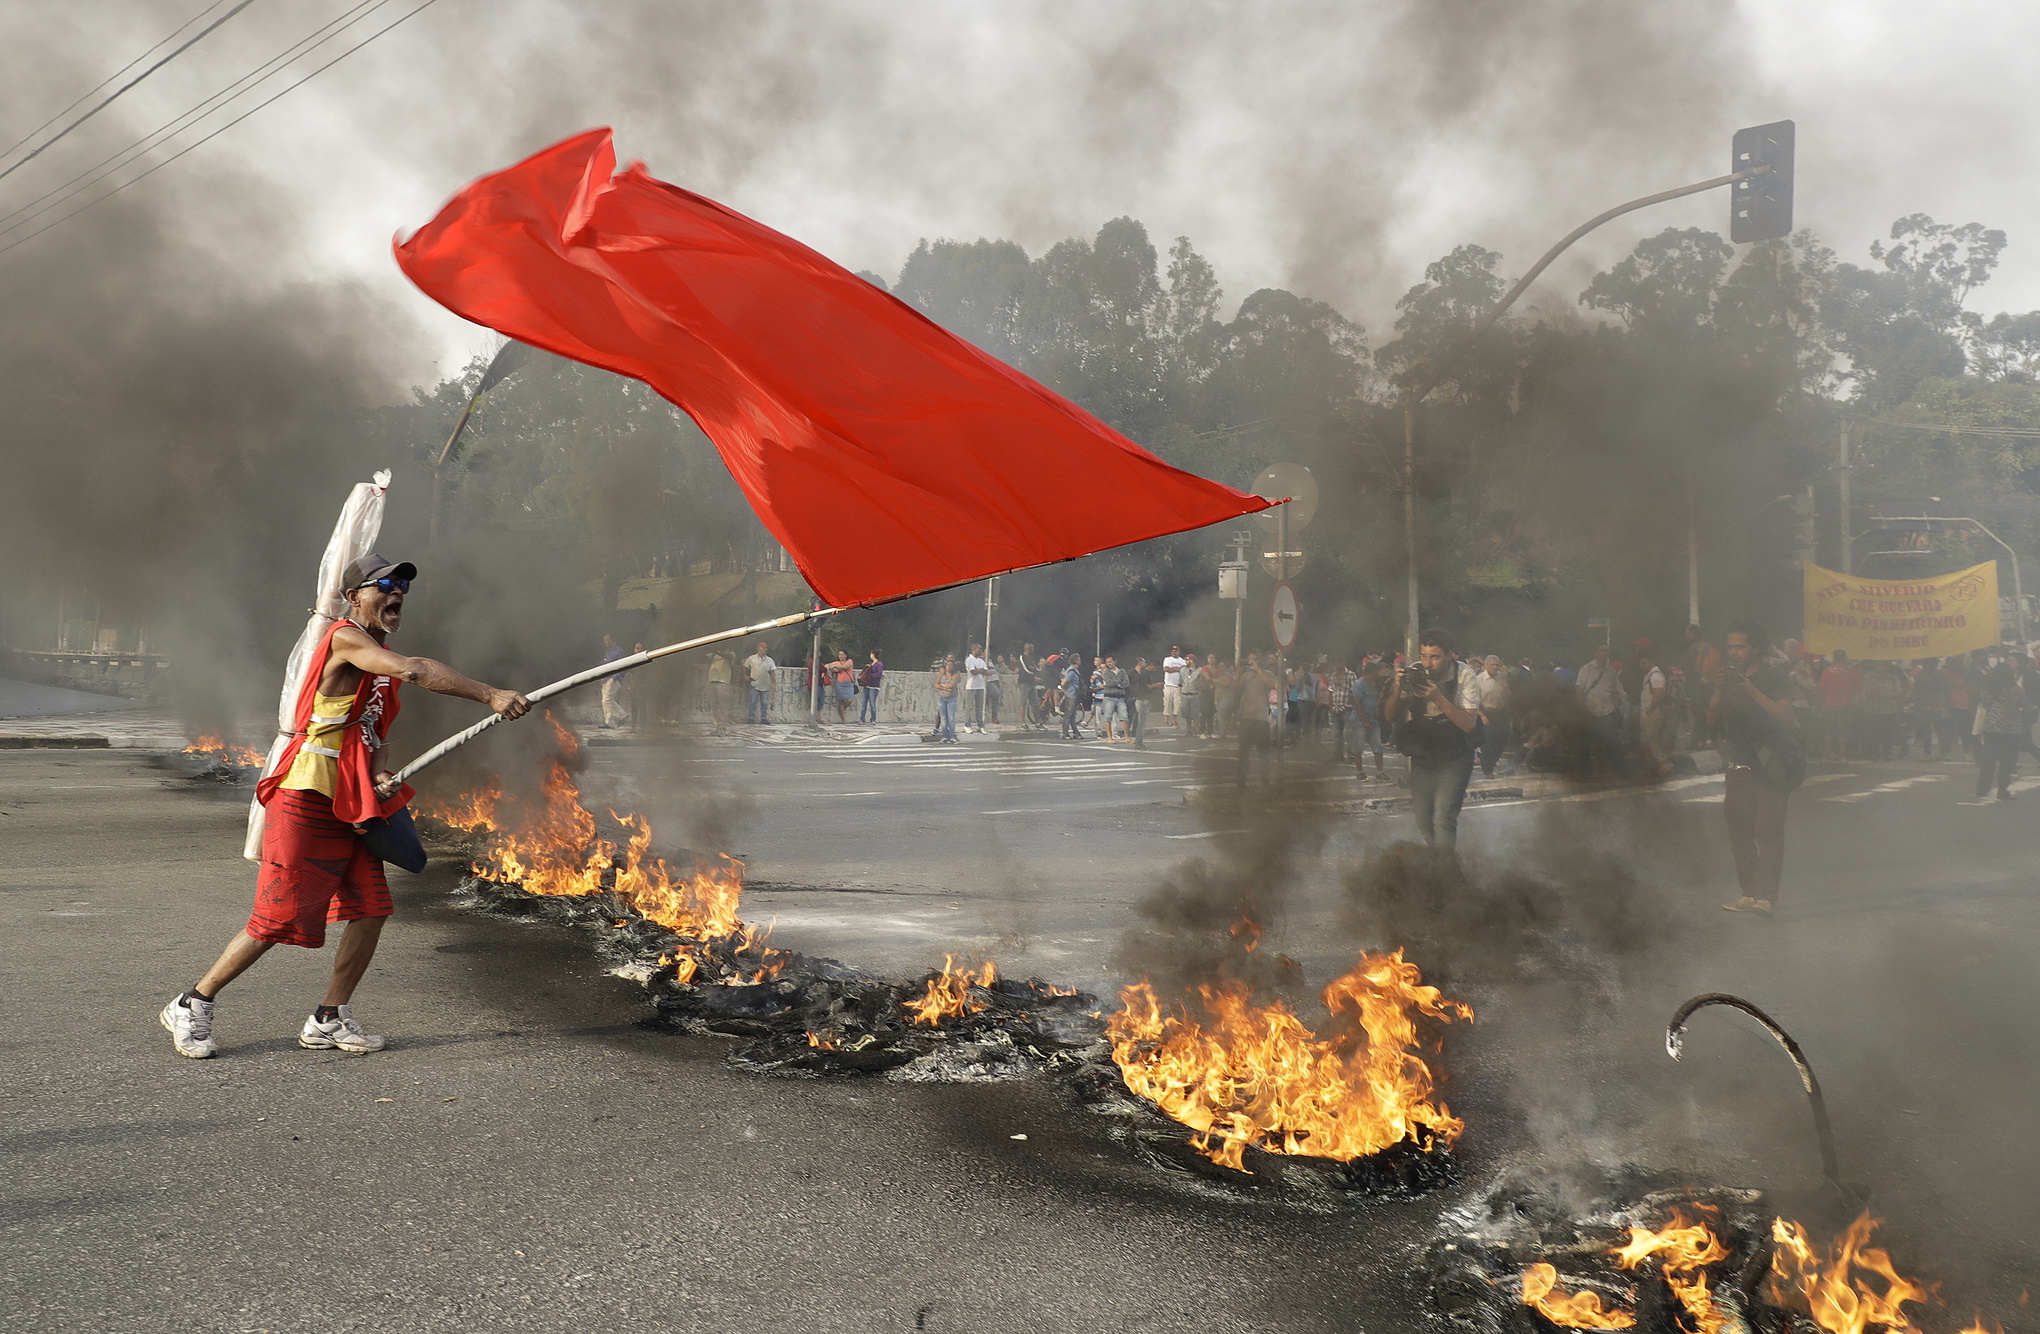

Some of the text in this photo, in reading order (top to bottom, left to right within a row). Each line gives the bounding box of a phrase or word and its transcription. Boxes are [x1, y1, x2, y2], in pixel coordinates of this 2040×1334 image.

[1849, 598, 1943, 613] CHE GUEVARA
[1817, 611, 1857, 627] NOVO
[1869, 635, 1889, 649] DO
